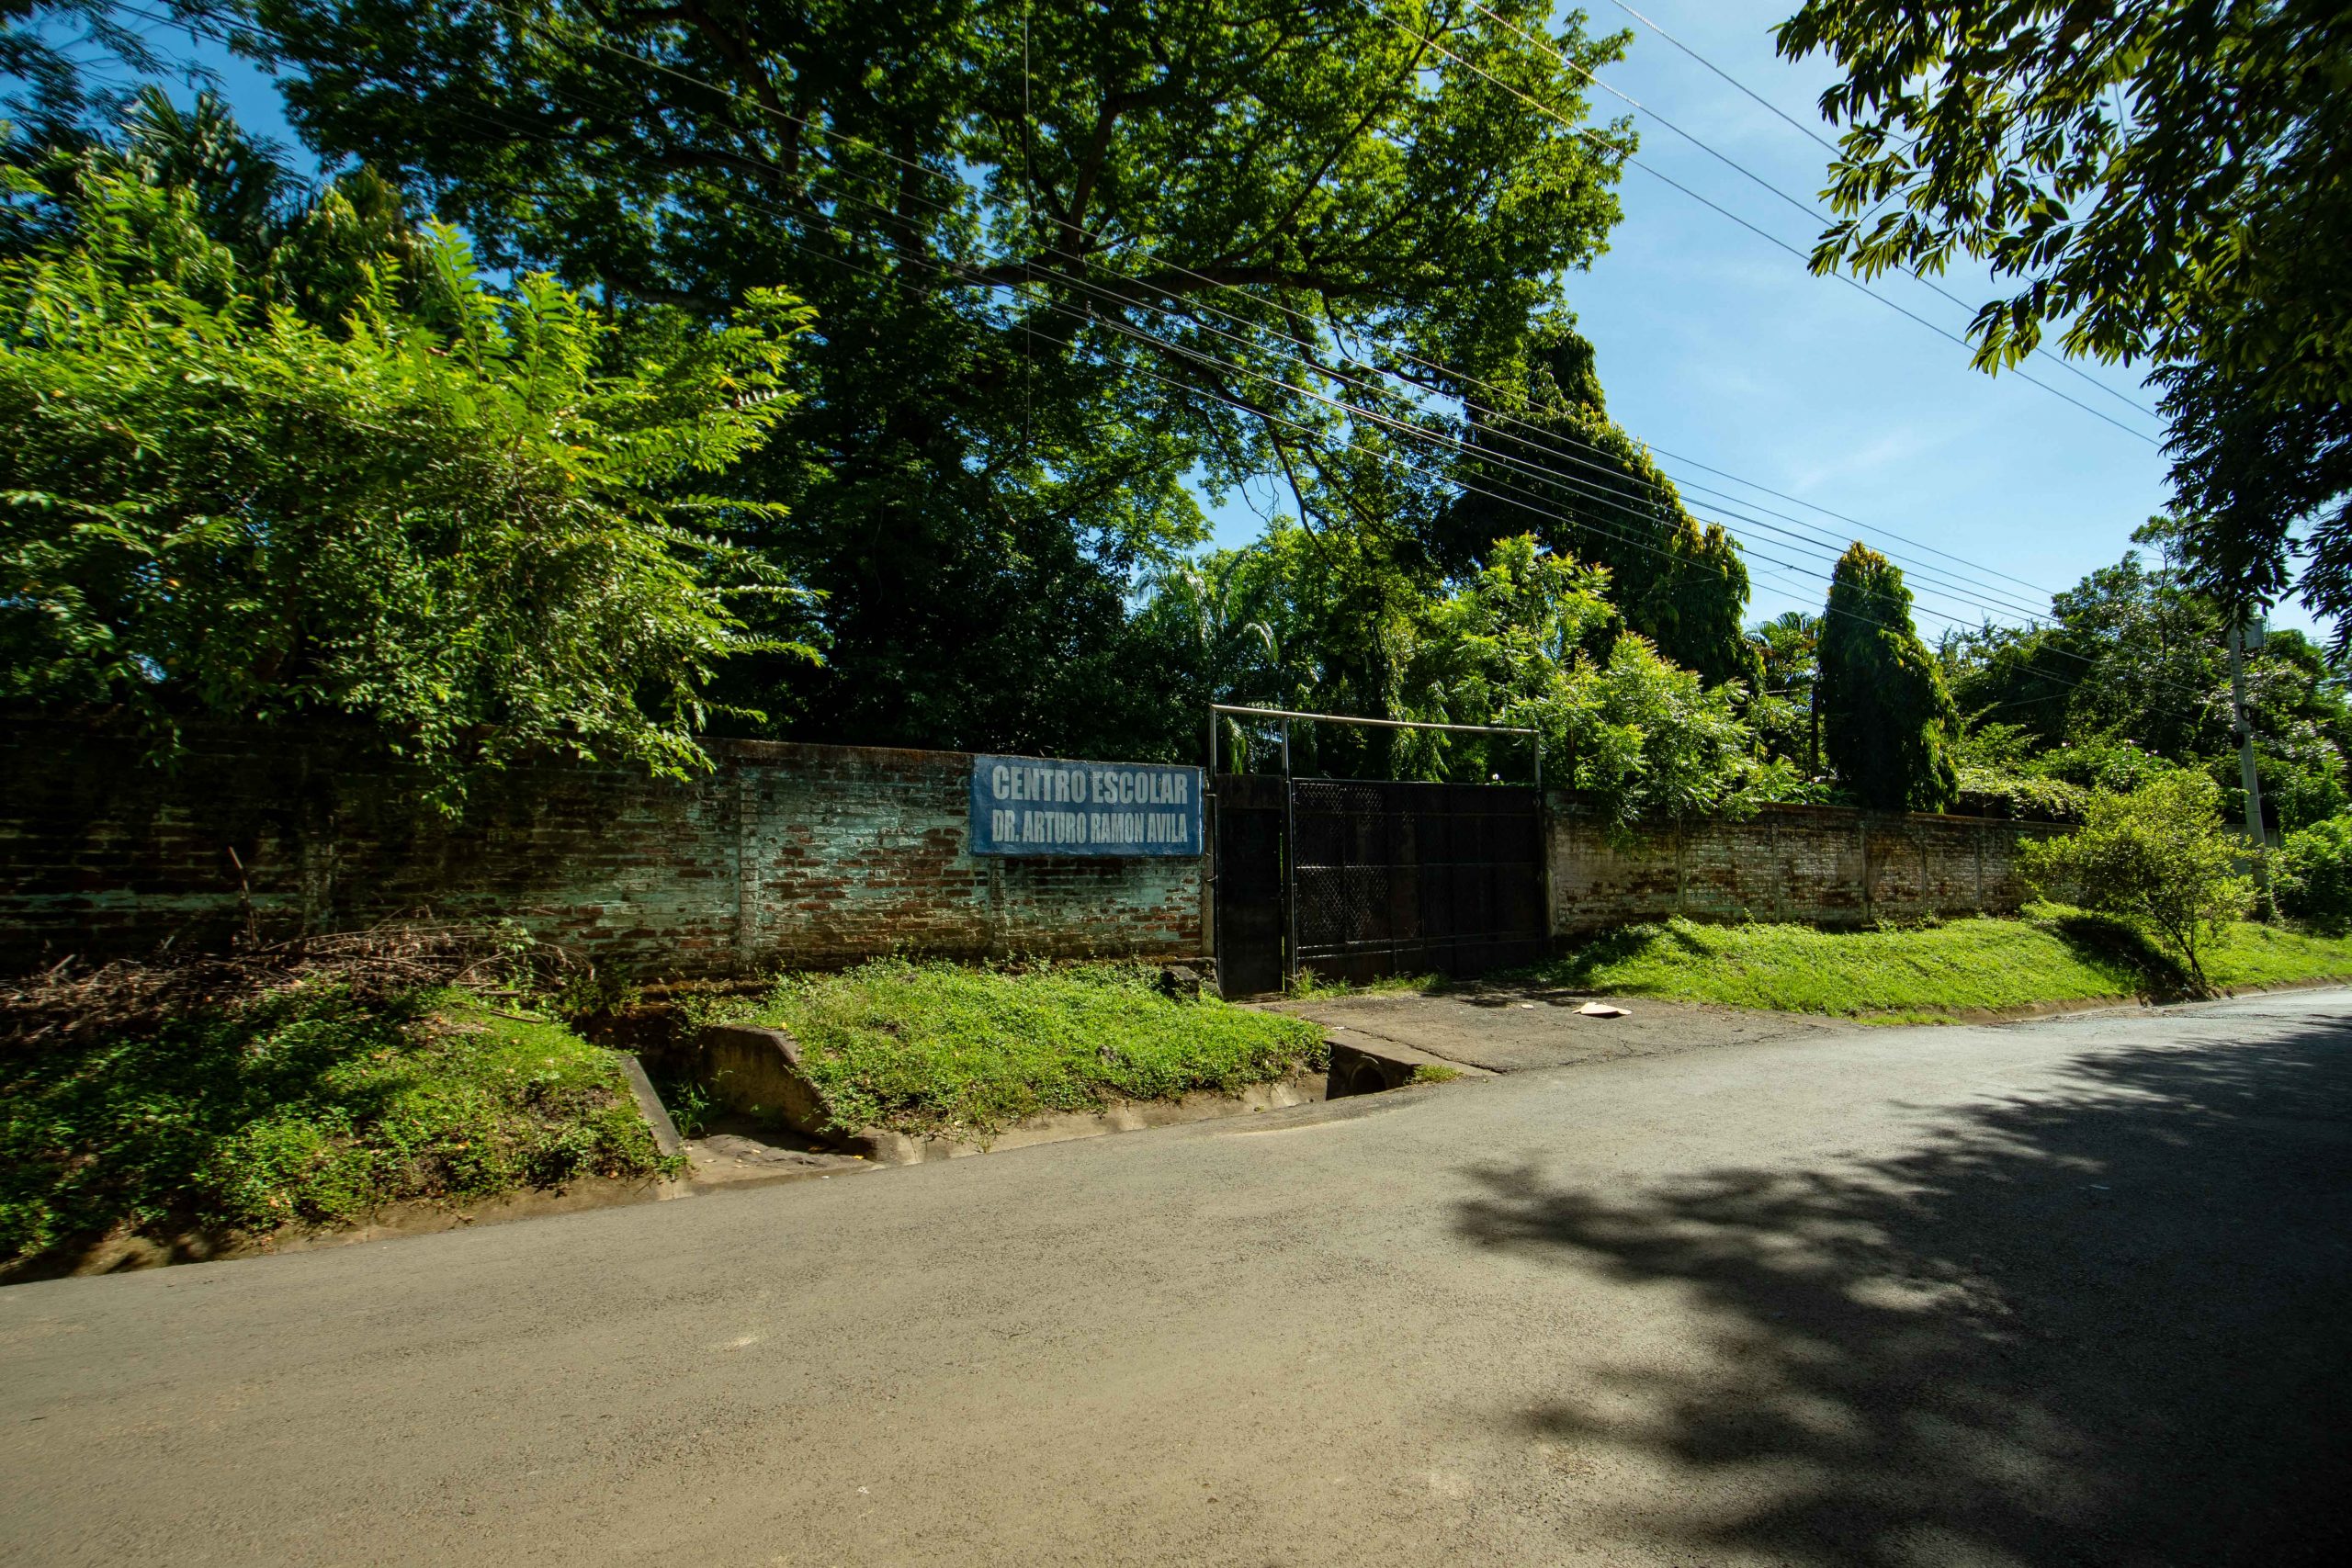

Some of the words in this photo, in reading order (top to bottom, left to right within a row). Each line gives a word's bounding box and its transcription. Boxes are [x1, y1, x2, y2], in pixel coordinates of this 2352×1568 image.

[992, 765, 1087, 804] CENTRO
[1092, 772, 1188, 805] ESCOLAR
[992, 809, 1020, 842] DR.
[1023, 810, 1087, 844] ARTURO
[1091, 812, 1145, 843] RAMON
[1147, 813, 1188, 843] AVILA
